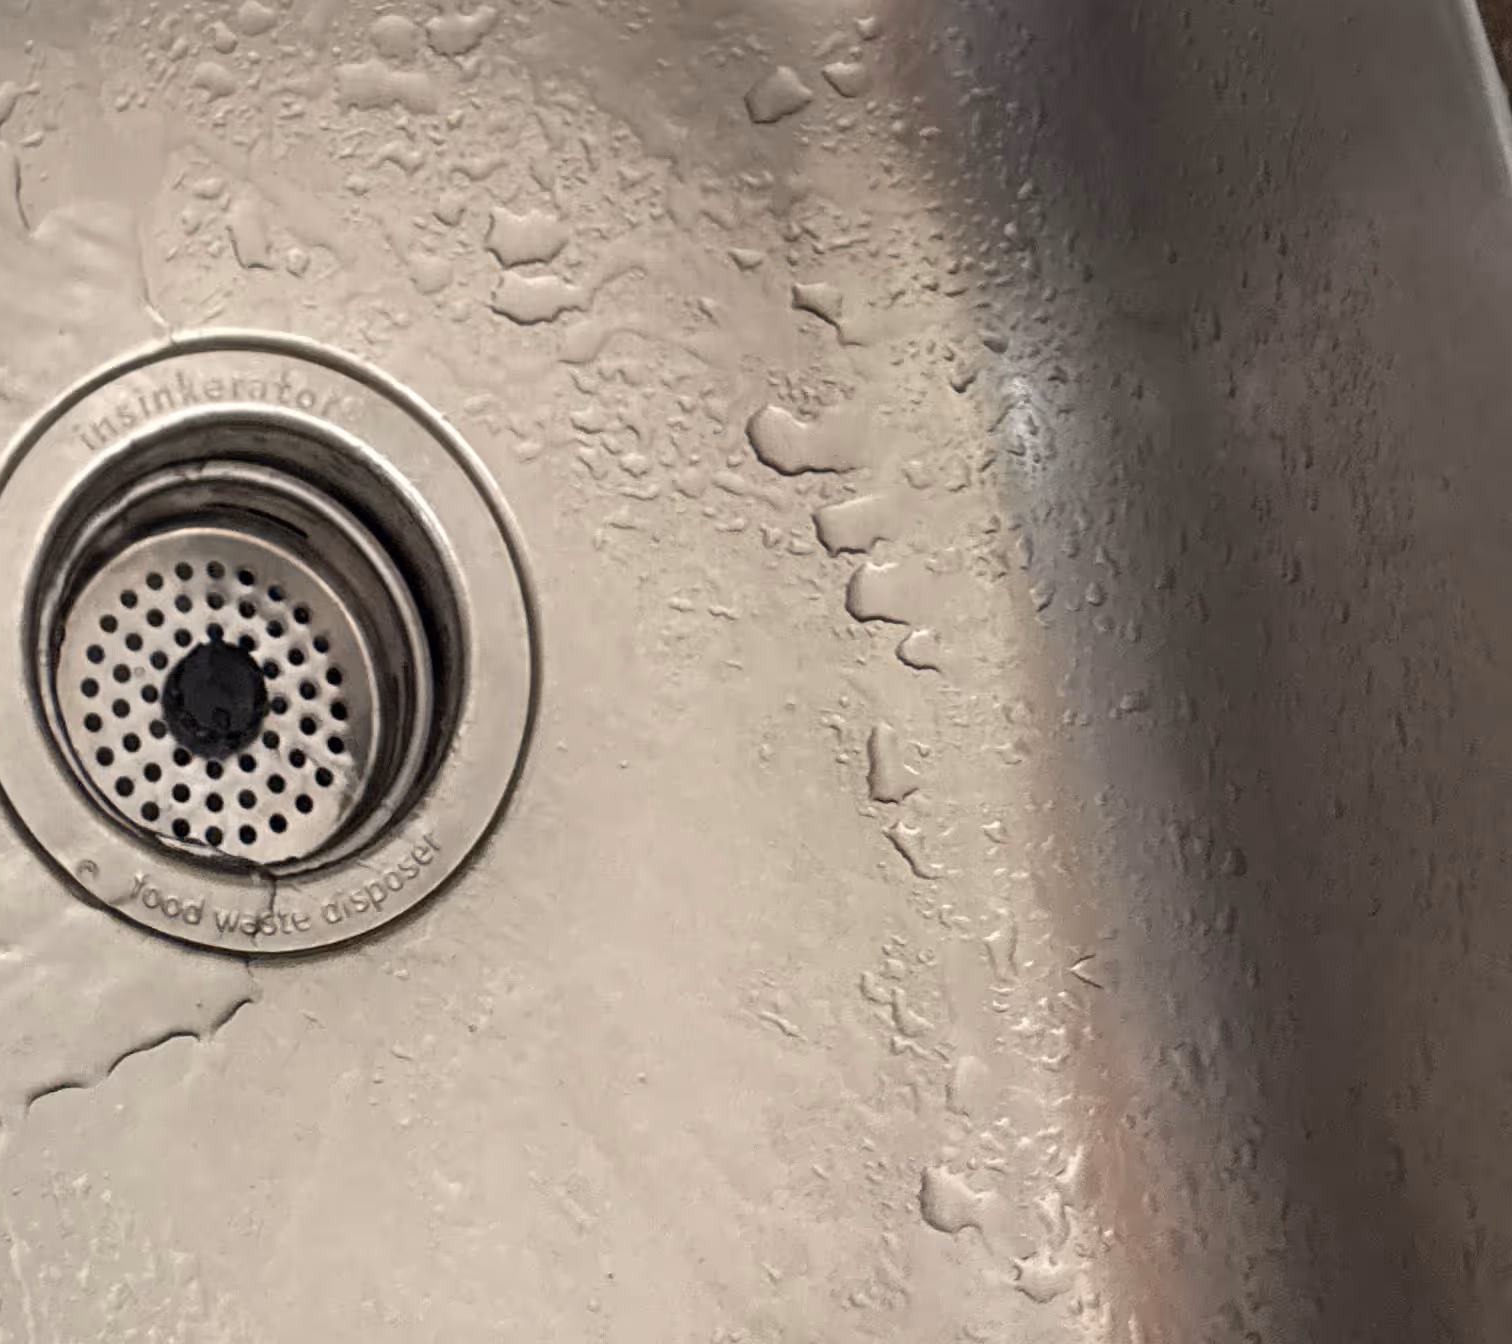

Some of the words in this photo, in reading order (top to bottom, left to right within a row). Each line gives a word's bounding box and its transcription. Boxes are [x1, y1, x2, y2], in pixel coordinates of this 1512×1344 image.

[133, 872, 206, 926] food
[213, 907, 313, 941] waste
[320, 832, 441, 925] disposer
